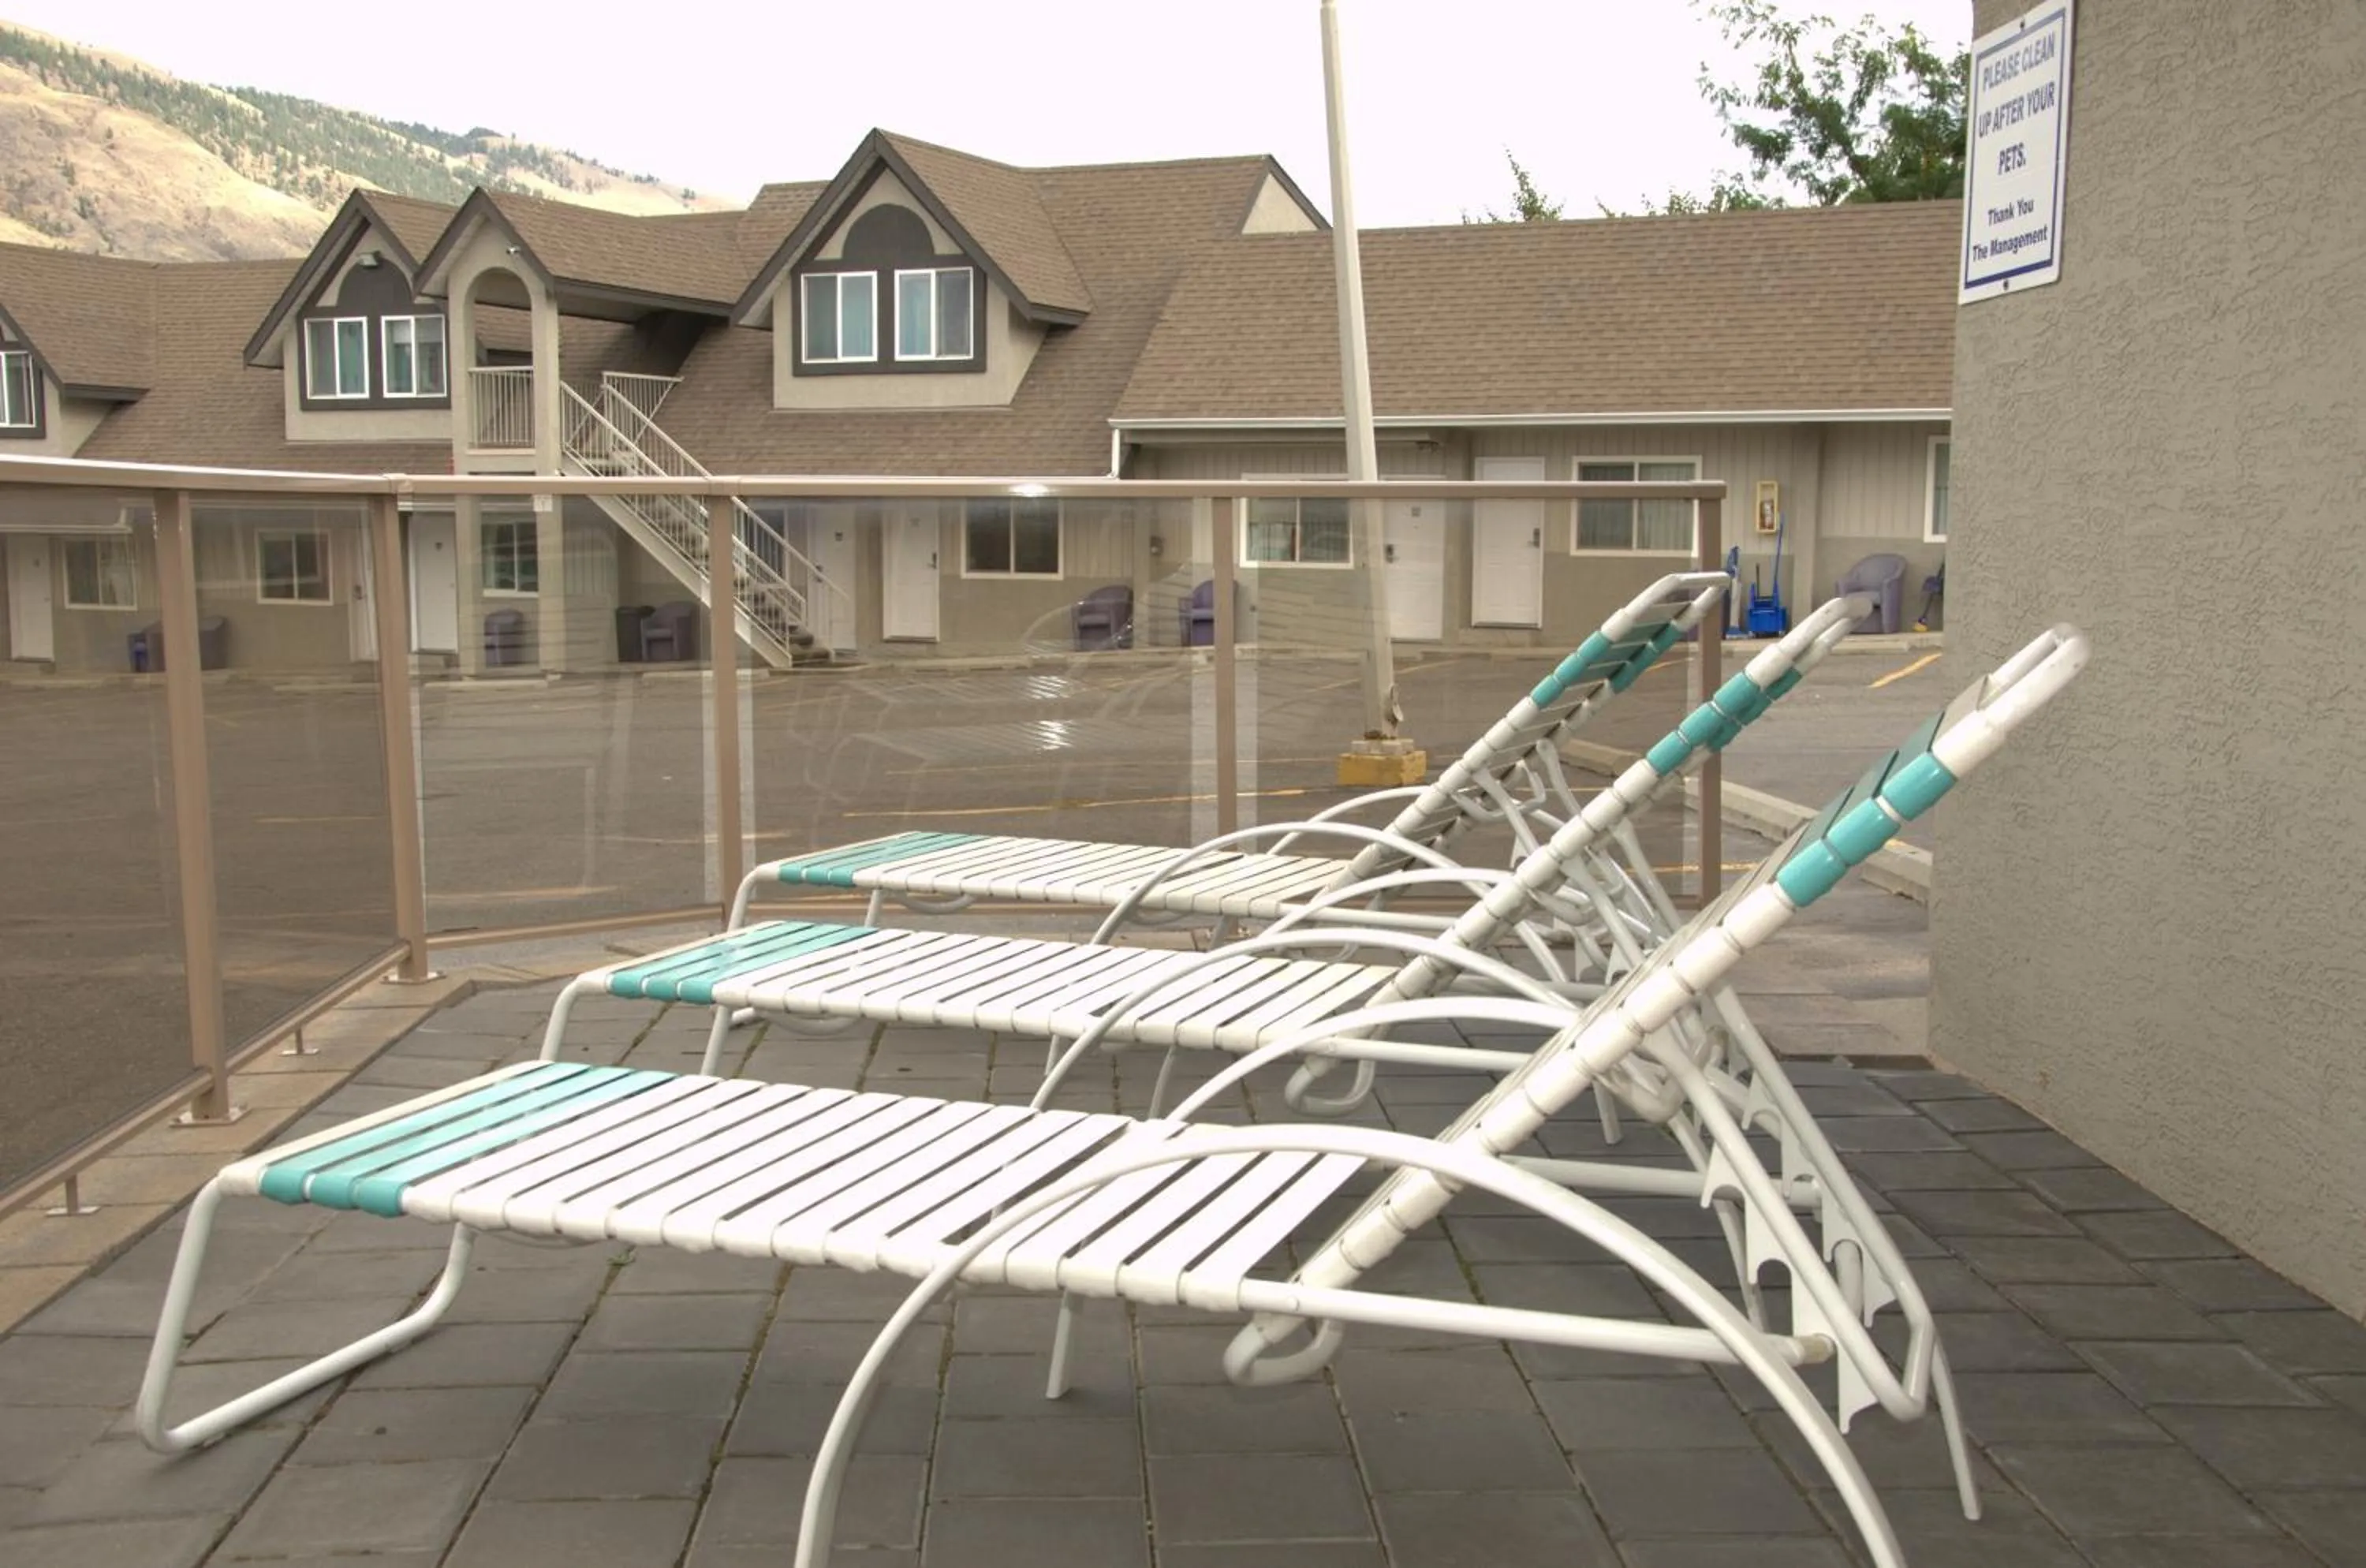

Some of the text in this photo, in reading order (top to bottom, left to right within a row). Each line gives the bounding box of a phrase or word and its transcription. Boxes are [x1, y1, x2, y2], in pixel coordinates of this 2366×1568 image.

[1983, 32, 2055, 91] PLEASE CLEAN
[1979, 81, 2055, 138] UP AFTER YOUR
[1998, 142, 2026, 175] PETS.
[1988, 196, 2034, 227] Thank You
[1972, 223, 2048, 262] The Management
